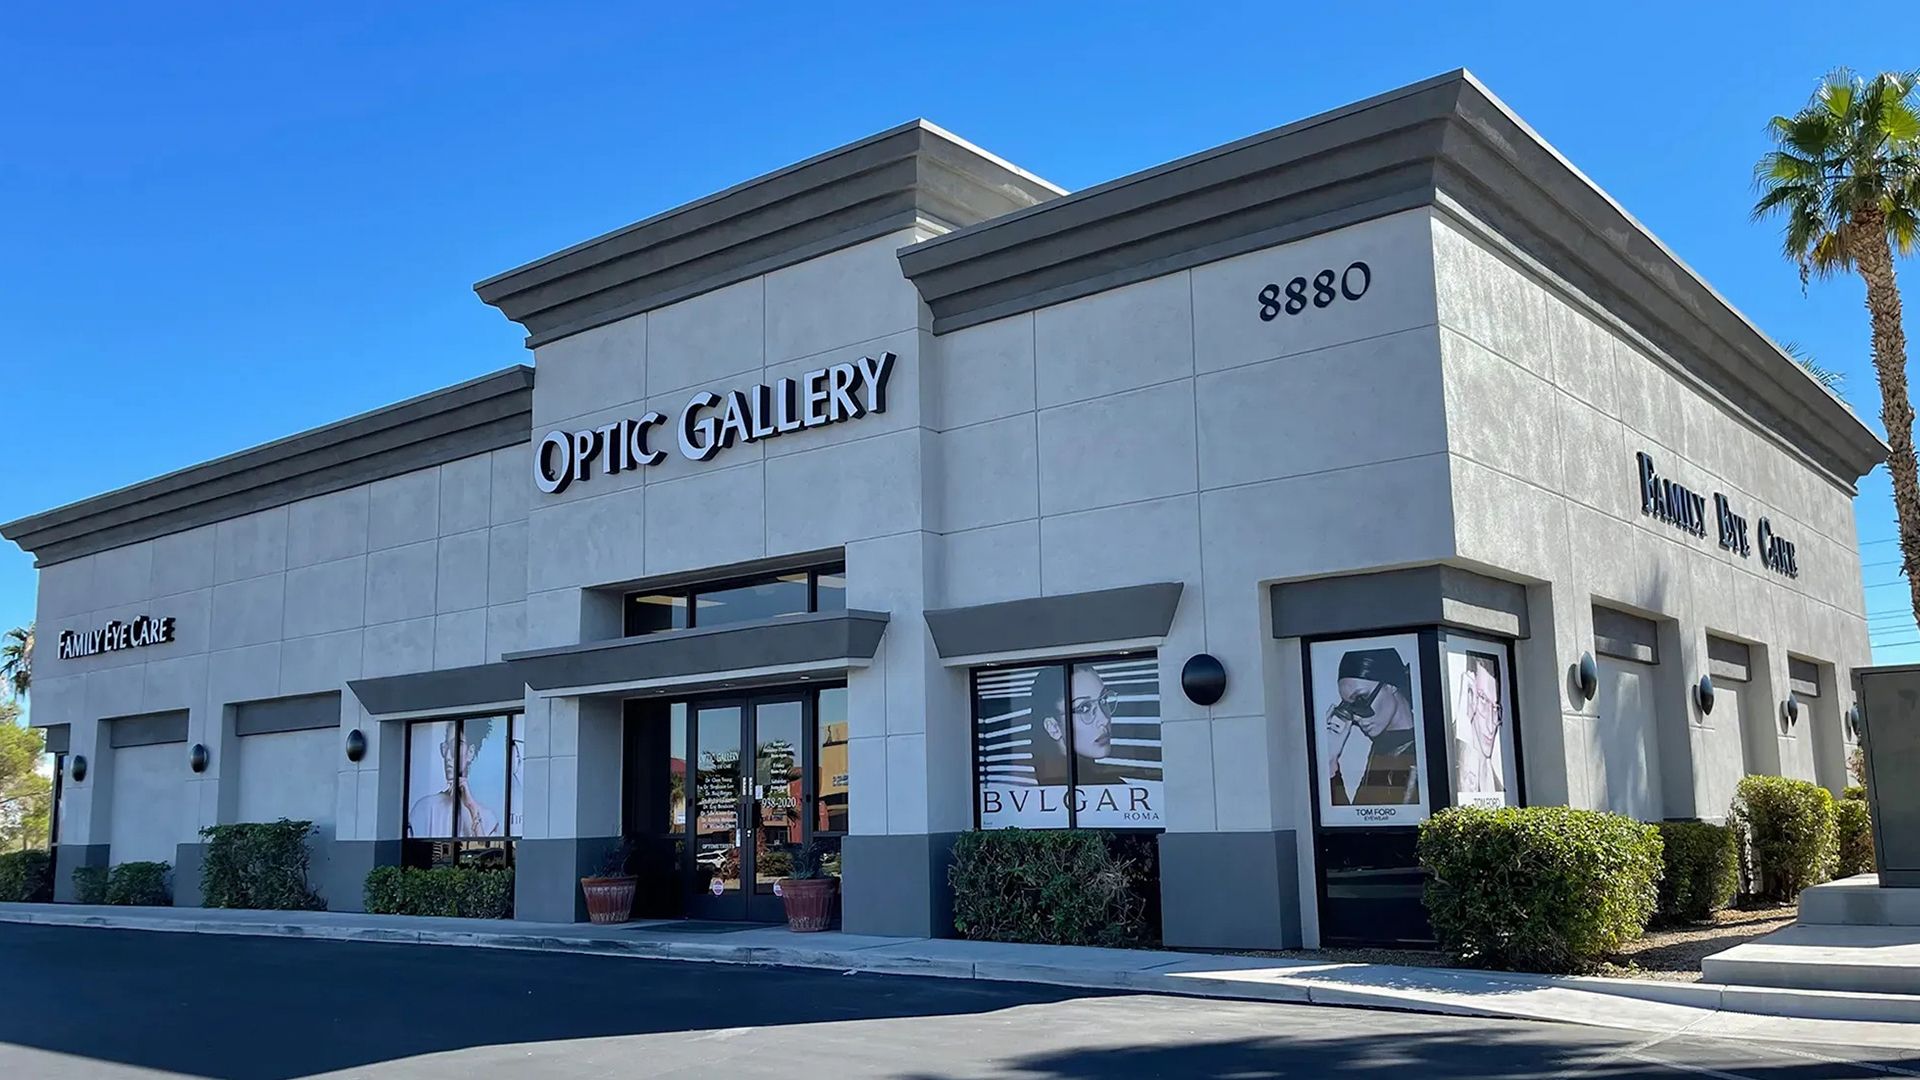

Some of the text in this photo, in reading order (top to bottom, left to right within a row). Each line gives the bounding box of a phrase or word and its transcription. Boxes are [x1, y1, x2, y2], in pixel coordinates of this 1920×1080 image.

[1258, 261, 1371, 321] 8880
[533, 351, 896, 494] OPTIC GALLERY
[1636, 451, 1798, 579] FAMILY EYE CARE
[57, 615, 170, 660] FAMILY EYE CARE
[983, 787, 1152, 814] BVLGAR
[1124, 812, 1160, 821] ROMA
[1355, 808, 1396, 816] TOM FORD
